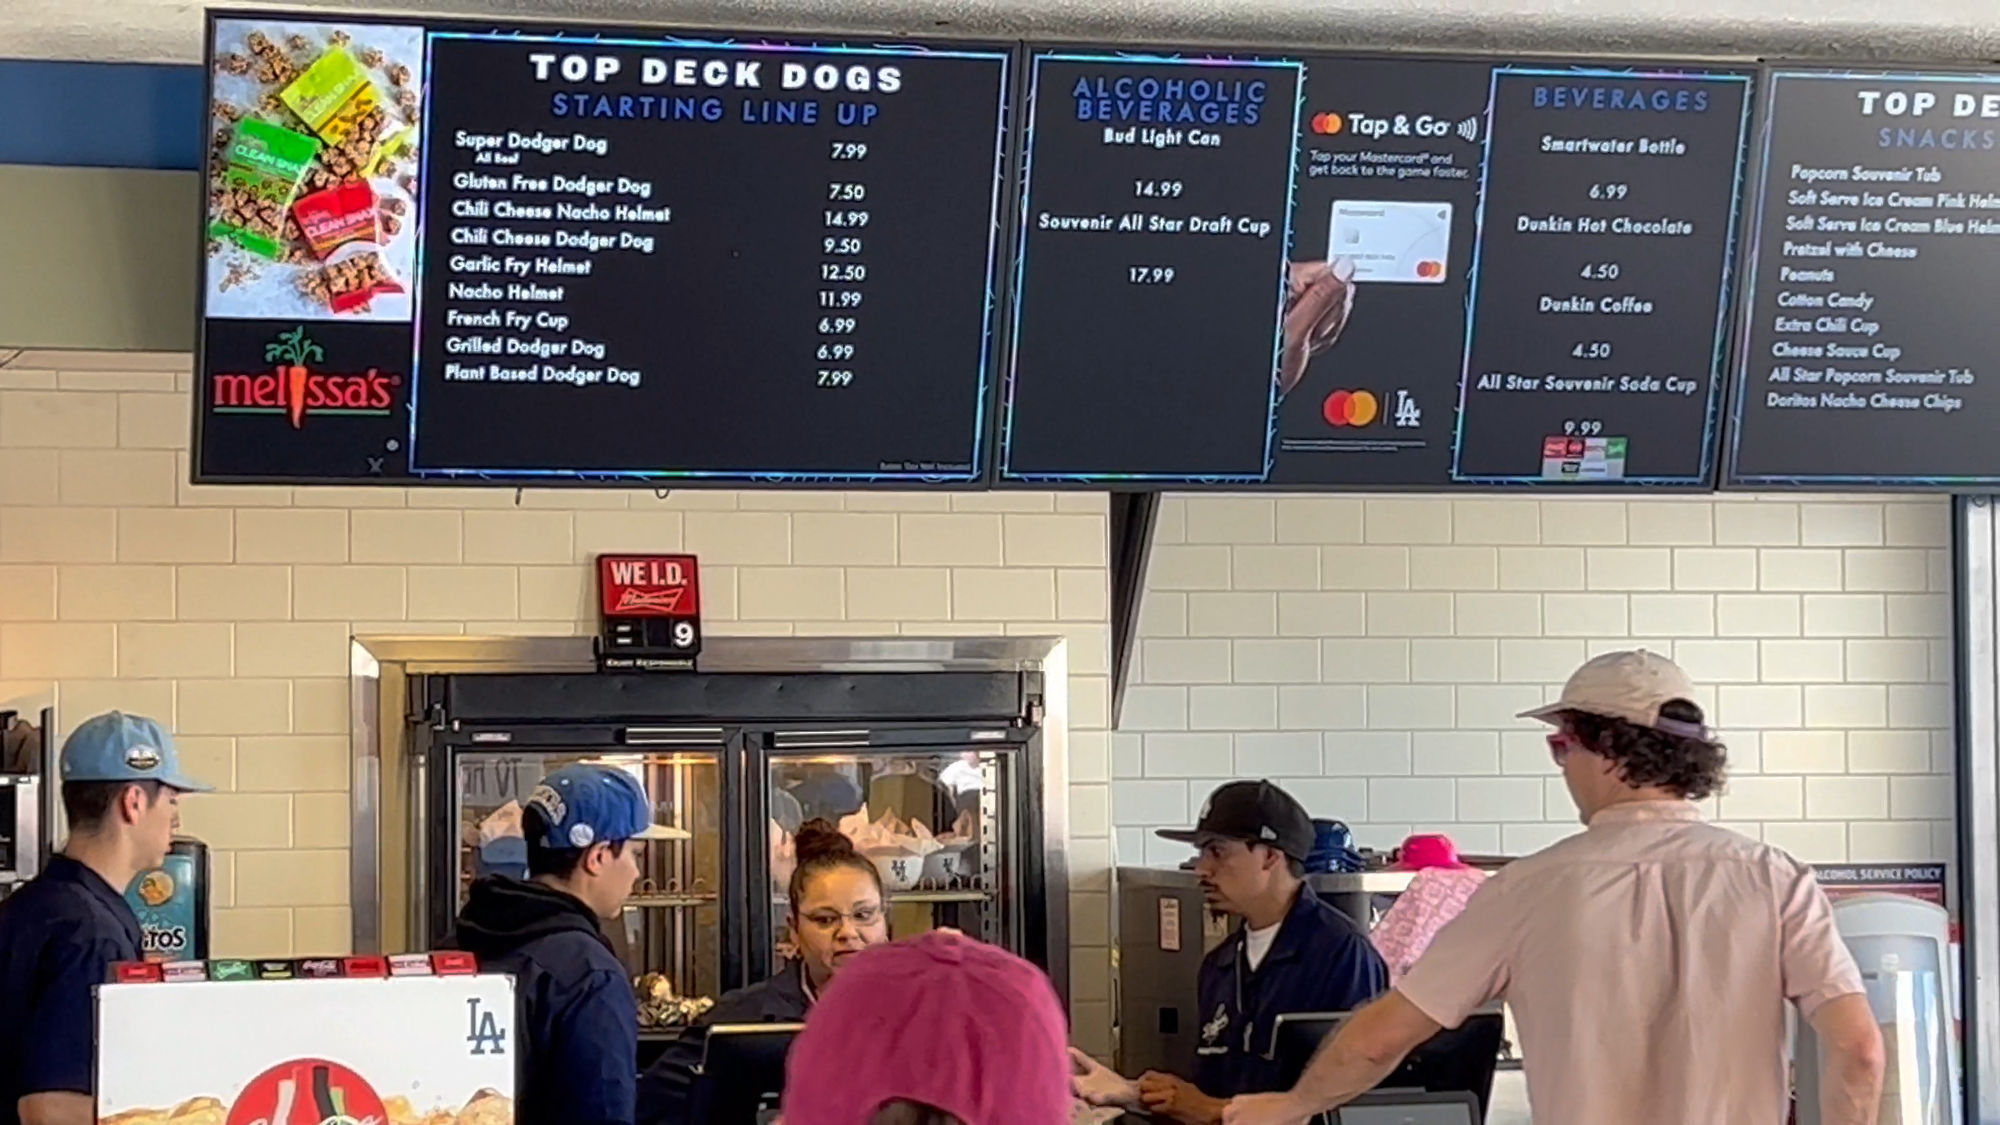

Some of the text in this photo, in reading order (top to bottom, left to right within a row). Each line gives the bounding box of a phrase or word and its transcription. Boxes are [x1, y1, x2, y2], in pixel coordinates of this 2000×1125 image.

[530, 54, 900, 91] TOP DECK DOGS
[1074, 78, 1264, 106] ALCOHOLIC
[1535, 87, 1707, 110] BEVERAGES
[554, 93, 877, 124] STARTING LINE UP
[1078, 96, 1262, 124] BEVERAGES
[1858, 92, 2000, 117] TOP DE
[1349, 114, 1450, 139] Tap & Go
[456, 131, 607, 155] Super Dodger Dog
[1104, 127, 1220, 147] Bud Light Can
[1542, 136, 1685, 154] Smartwater Bottle
[1880, 128, 1999, 149] SNACKS
[235, 145, 275, 168] CLEAN
[833, 143, 867, 158] 7.99
[1310, 150, 1333, 162] Tap
[1332, 154, 1357, 163] your
[1431, 154, 1452, 164] and
[1309, 165, 1328, 176] get
[1331, 164, 1358, 174] back
[1361, 166, 1374, 175] to
[1377, 166, 1395, 175] the
[1398, 168, 1430, 178] game
[1792, 165, 1941, 183] Popcorn Souvenir Tub
[454, 172, 651, 198] Gluten Free Dodger Dog
[830, 184, 864, 199] 7.50
[1136, 182, 1182, 196] 14.99
[1590, 185, 1627, 199] 6.99
[1788, 190, 1817, 205] Soft
[1820, 191, 1859, 205] Serve
[1863, 192, 1884, 206] Ice
[1888, 192, 1933, 207] Cream
[1937, 193, 1965, 208] Pink
[453, 200, 670, 221] Chili Cheese Nacho Helmet
[826, 212, 868, 226] 14.99
[306, 217, 344, 237] CLEAN
[1040, 213, 1270, 237] Souvenir All Star Draft Cup
[1518, 216, 1691, 234] Dunkin Hot Chocolate
[1786, 215, 1814, 230] Soft
[1817, 216, 1856, 231] Serve
[1861, 218, 1881, 232] Ice
[1885, 218, 1930, 232] Cream
[1935, 218, 1964, 233] Blue
[451, 227, 654, 252] Chili Cheese Dodger Dog
[825, 238, 860, 253] 9.50
[1784, 241, 1917, 257] Pretzel with Cheese
[450, 255, 591, 276] Garlic Fry Helmet
[823, 265, 865, 280] 12.50
[1131, 268, 1174, 282] 17.99
[1581, 265, 1618, 278] 4.50
[1781, 267, 1834, 281] Peanuts
[450, 283, 563, 300] Nacho Helmet
[821, 292, 861, 306] 11.99
[1540, 296, 1652, 312] Dunkin Coffee
[1778, 292, 1873, 311] Cotton Candy
[448, 310, 568, 331] French Fry Cup
[820, 318, 855, 332] 6.99
[1775, 317, 1879, 336] Extra Chili Cup
[447, 337, 604, 359] Grilled Dodger Dog
[818, 345, 853, 359] 6.99
[1573, 344, 1610, 357] 4.50
[1773, 342, 1900, 361] Cheese Sauce Cup
[445, 364, 640, 386] Plant Based Dodger Dog
[818, 371, 852, 385] 7.99
[1478, 374, 1696, 395] All Star Souvenir Soda Cup
[1769, 367, 1973, 386] All Star Popcorn Souvenir Tub
[214, 366, 391, 411] melissa's
[1768, 393, 1961, 411] Doritos Nacho Cheese Chips
[1564, 420, 1602, 436] 9.99
[610, 561, 688, 586] WE I.D.
[674, 622, 694, 647] 9
[1860, 868, 1902, 881] SERVICE
[1904, 868, 1943, 881] POLICY
[467, 997, 506, 1055] LA
